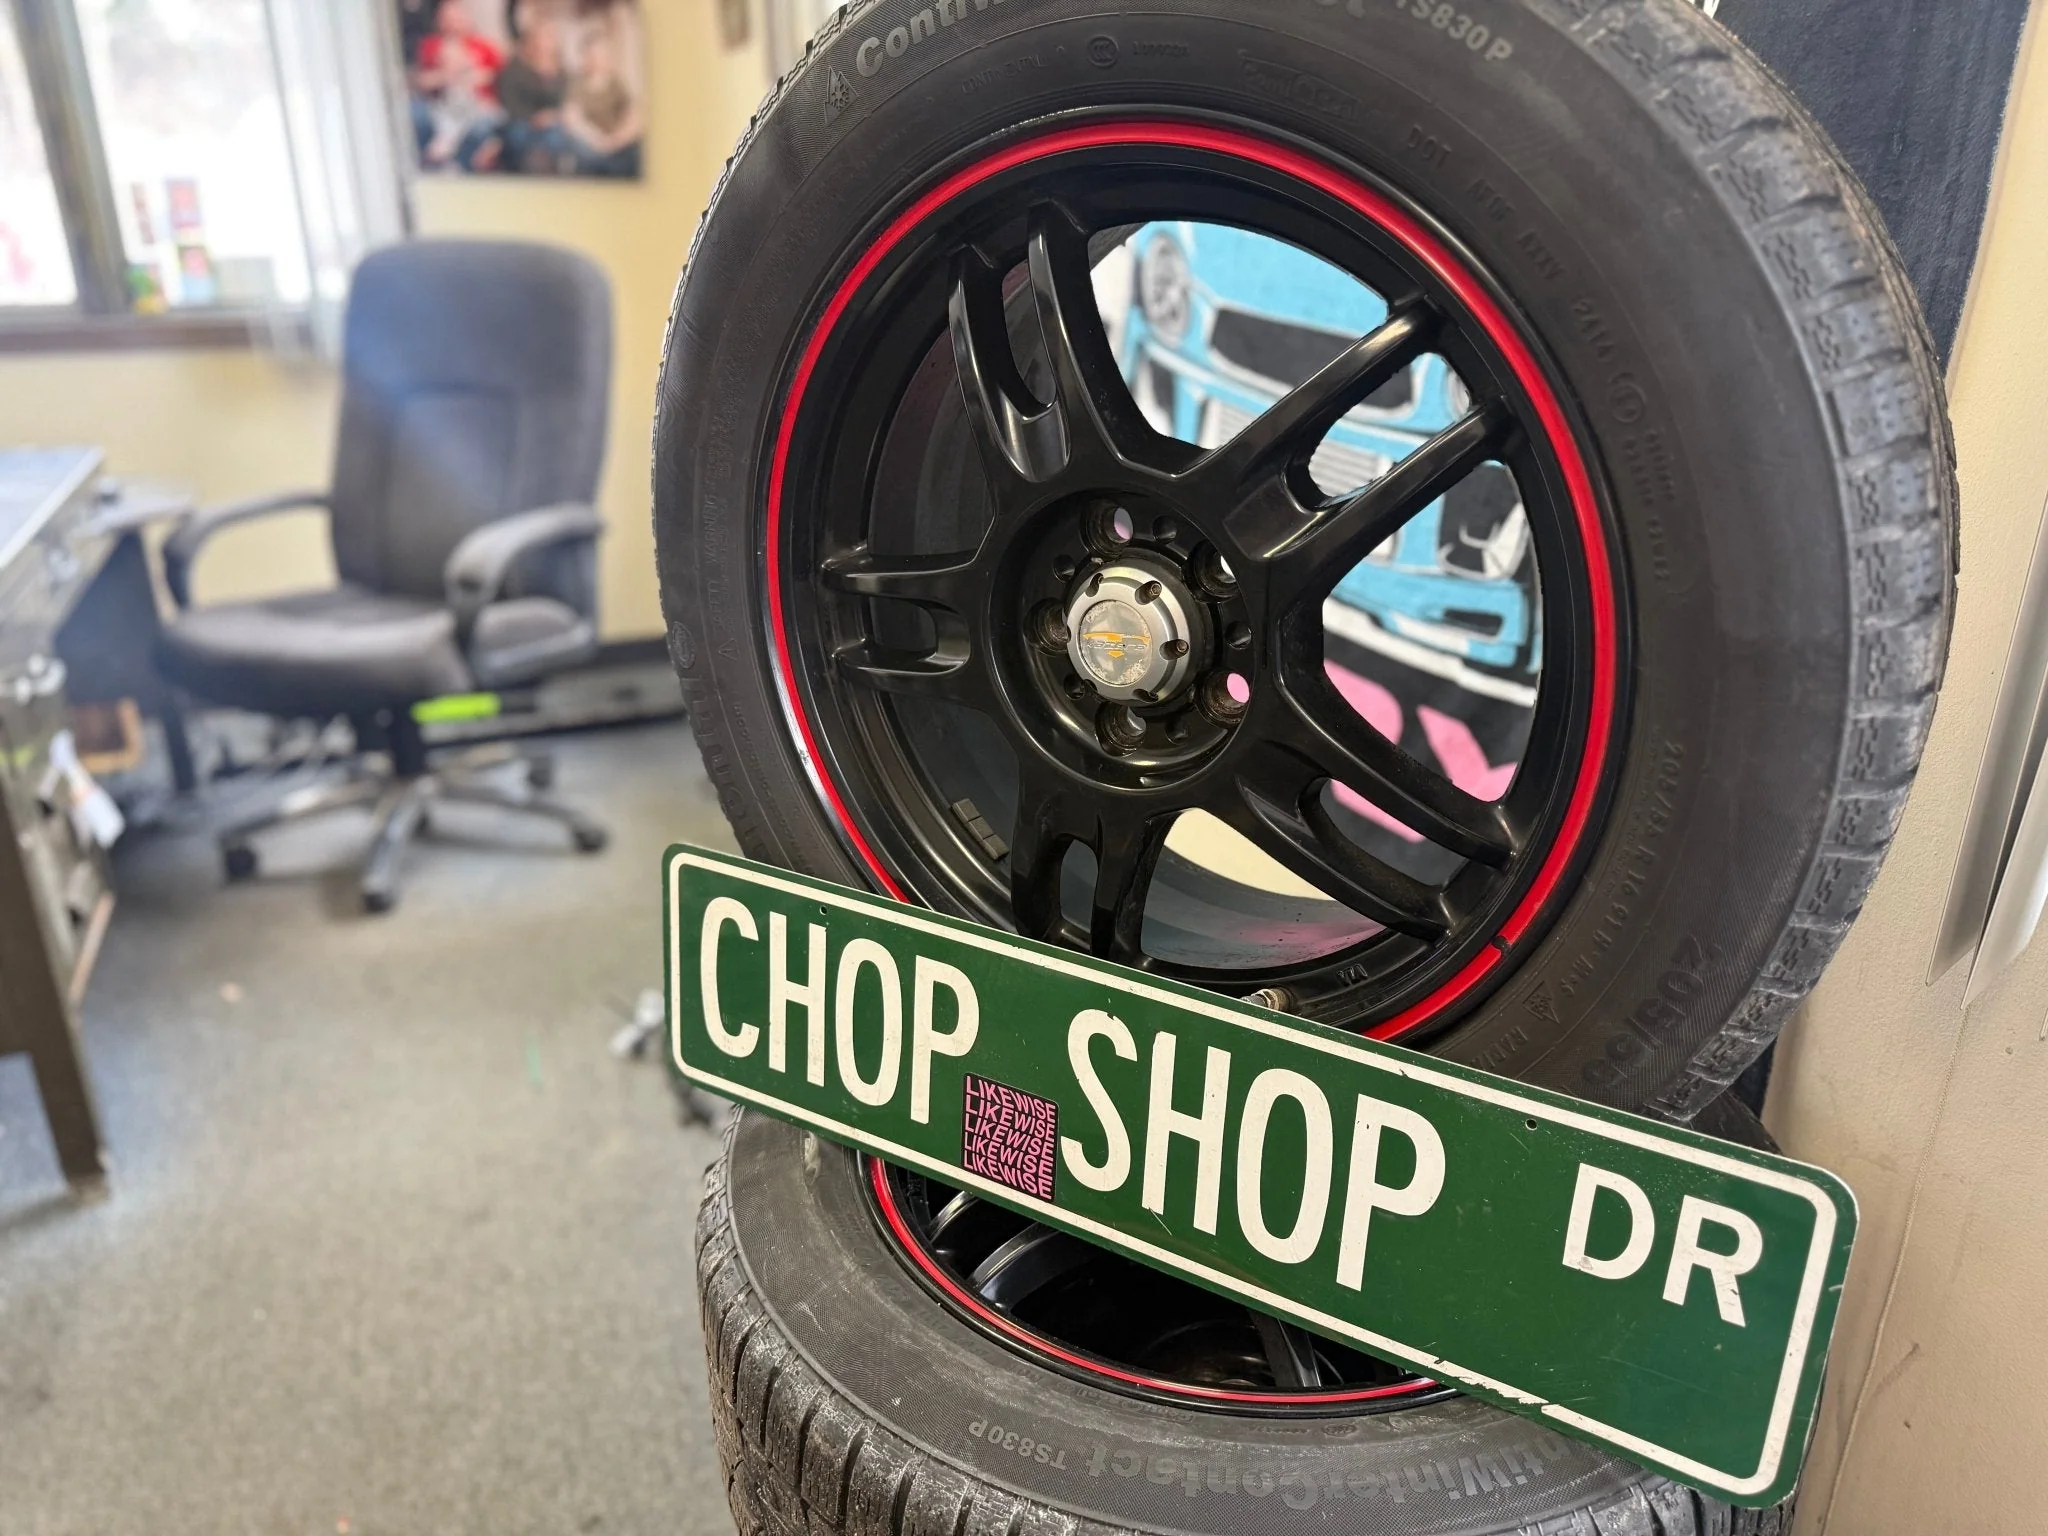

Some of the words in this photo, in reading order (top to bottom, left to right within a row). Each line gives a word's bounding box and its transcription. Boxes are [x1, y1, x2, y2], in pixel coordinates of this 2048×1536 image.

[701, 897, 979, 1124] CHOP
[1060, 1009, 1446, 1292] SHOP
[1562, 1163, 1763, 1328] DR
[965, 1094, 1055, 1142] LIKEWISE
[966, 1075, 1056, 1123] LIKEWISE
[964, 1112, 1054, 1161] LIKEWISE
[964, 1131, 1053, 1180] LIKEWISE
[963, 1149, 1052, 1200] LIKEWISE
[968, 1419, 1066, 1470] TS830P
